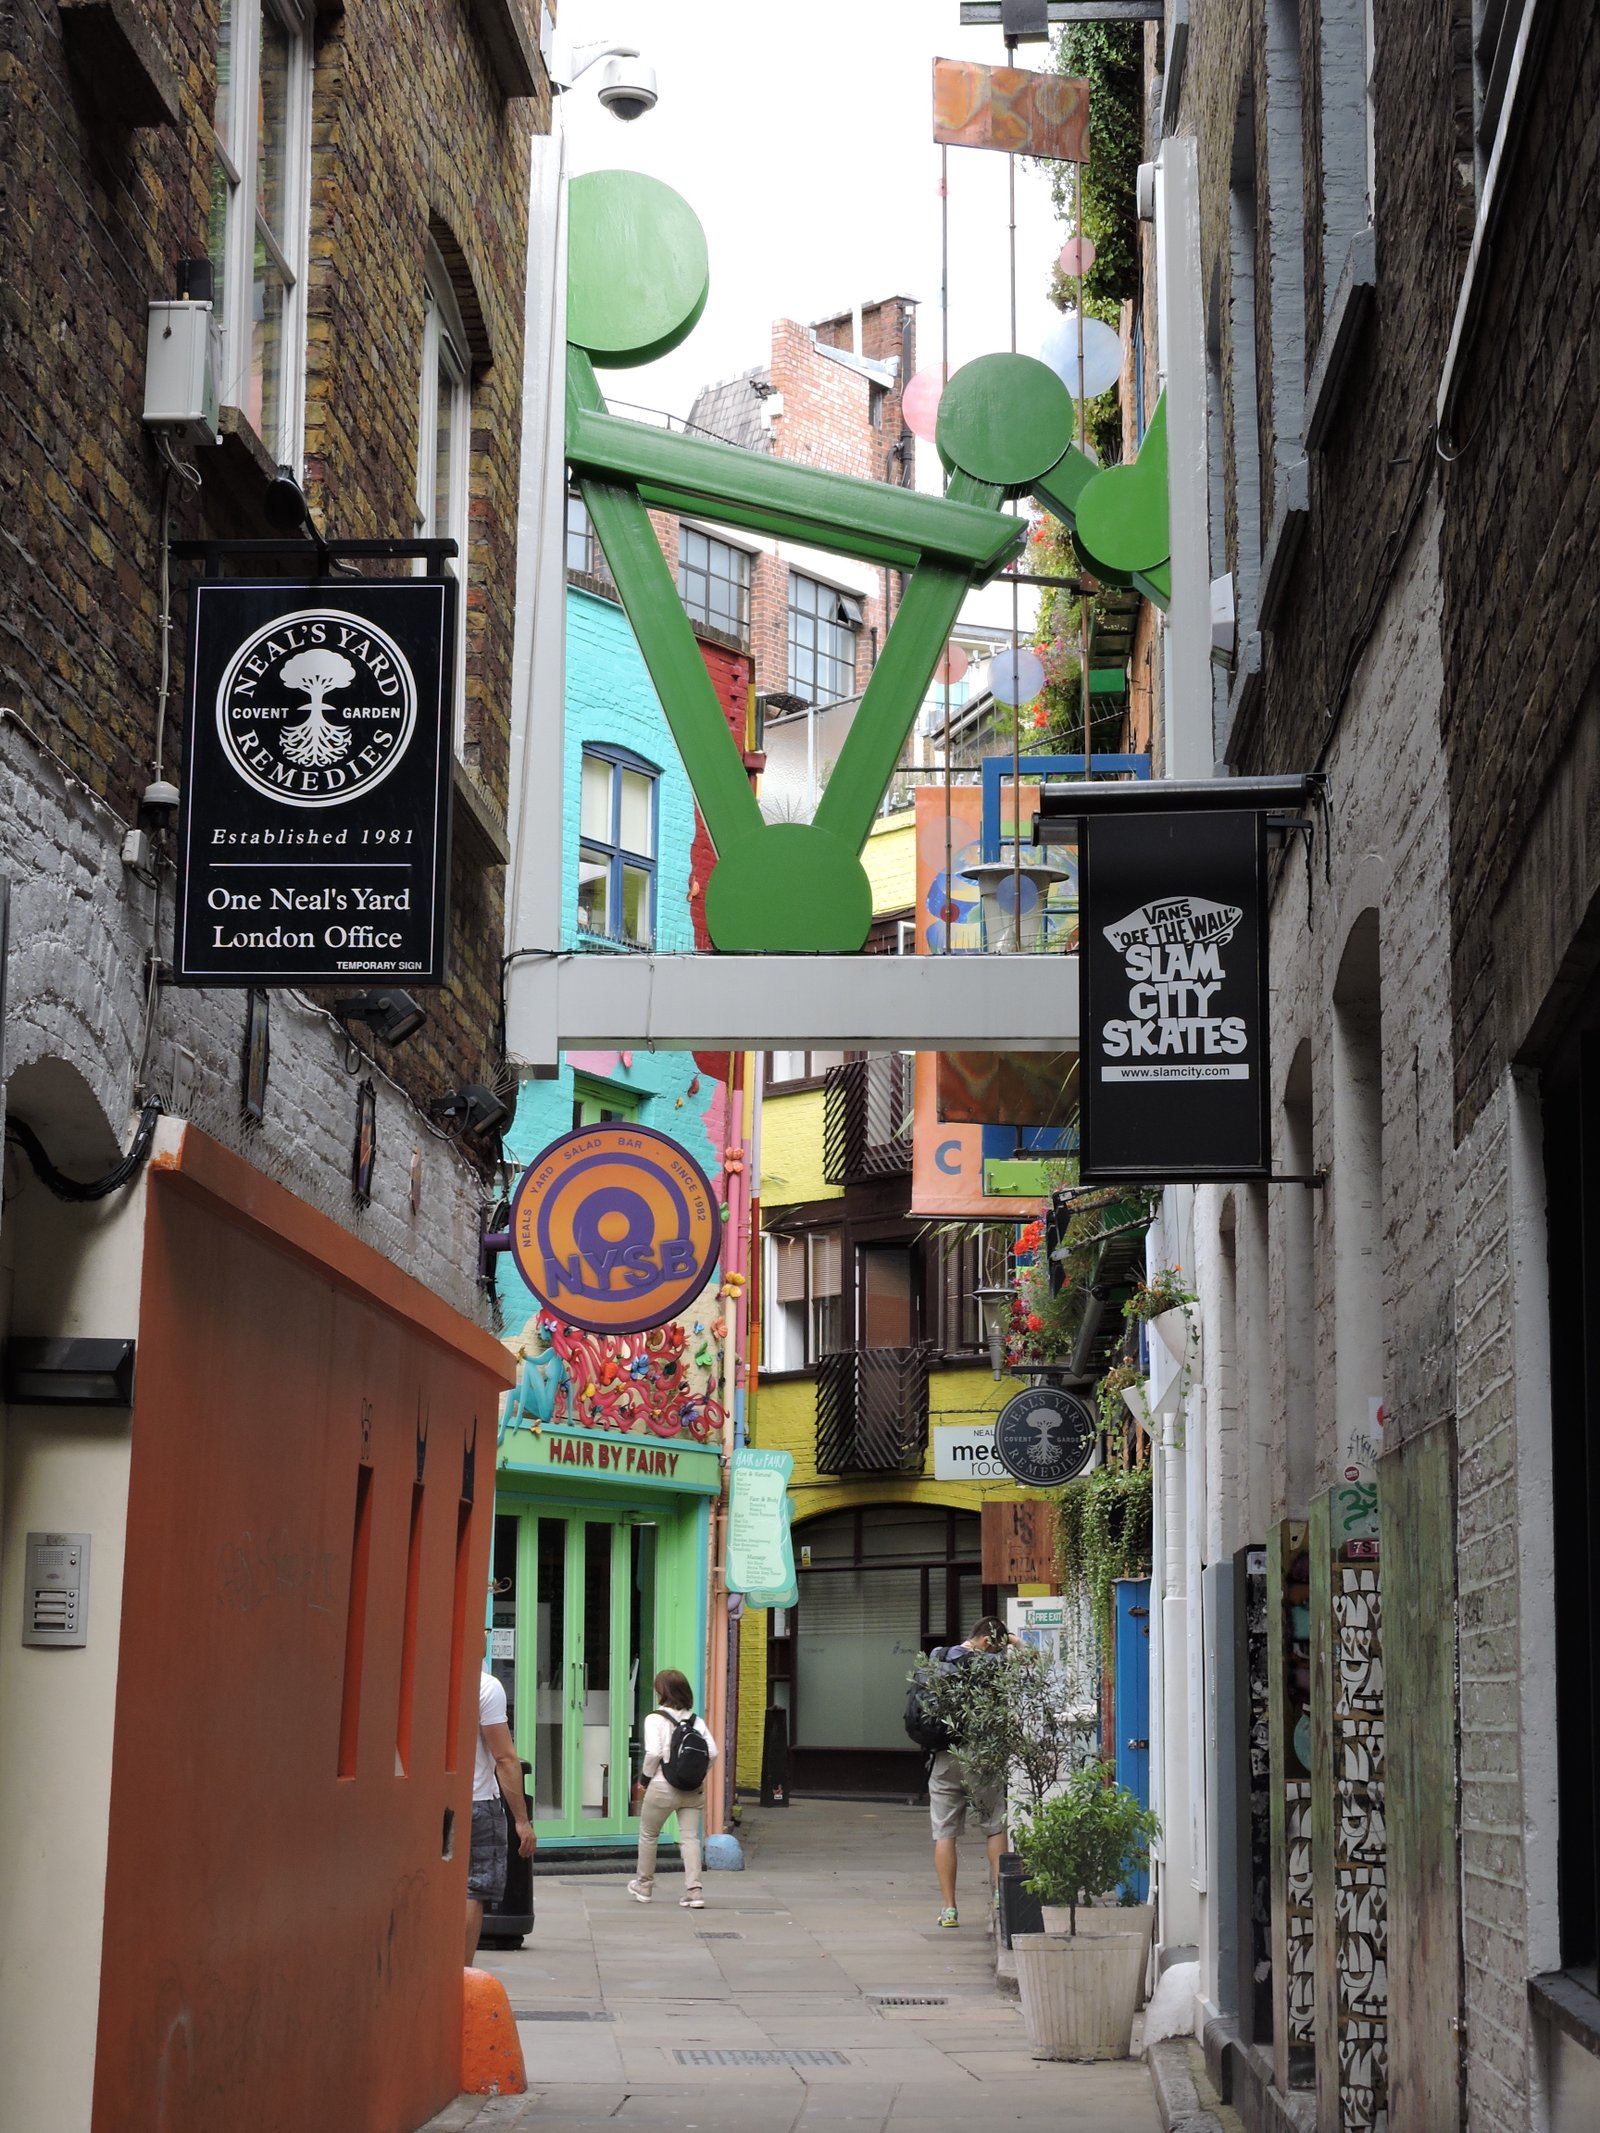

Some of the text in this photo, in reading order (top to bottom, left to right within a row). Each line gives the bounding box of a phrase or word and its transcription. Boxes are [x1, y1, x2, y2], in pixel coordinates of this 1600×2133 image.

[234, 624, 399, 698] NEAL'S YARD
[232, 707, 401, 720] COVENT GARDEN
[237, 729, 393, 791] REMEDIES
[211, 828, 414, 845] Established 1981
[207, 887, 411, 911] One Neal's Yard
[1142, 898, 1193, 925] VANS
[212, 925, 403, 949] London Office
[1151, 920, 1190, 946] THE
[336, 961, 423, 971] TEMPORARY SIGN
[1125, 943, 1227, 982] SLAM
[1129, 980, 1222, 1020] CITY
[1101, 1016, 1248, 1058] SKATES
[1120, 1066, 1230, 1079] www.slamcity.com
[521, 1136, 706, 1248] NEALS YARD SALAD BAR SINCE 1982
[543, 1239, 698, 1298] NYSB
[1055, 1397, 1085, 1434] YARD
[973, 1429, 995, 1437] NEAL
[550, 1437, 680, 1478] HAIR BY FAIRY
[735, 1451, 754, 1467] HAIR
[763, 1453, 788, 1469] FAIRY
[951, 1443, 1000, 1462] mee
[1009, 1448, 1081, 1478] REMEDIES
[971, 1461, 1009, 1476] roo
[1009, 1556, 1037, 1573] PIZZA
[1035, 1612, 1062, 1622] FIRE EXIT
